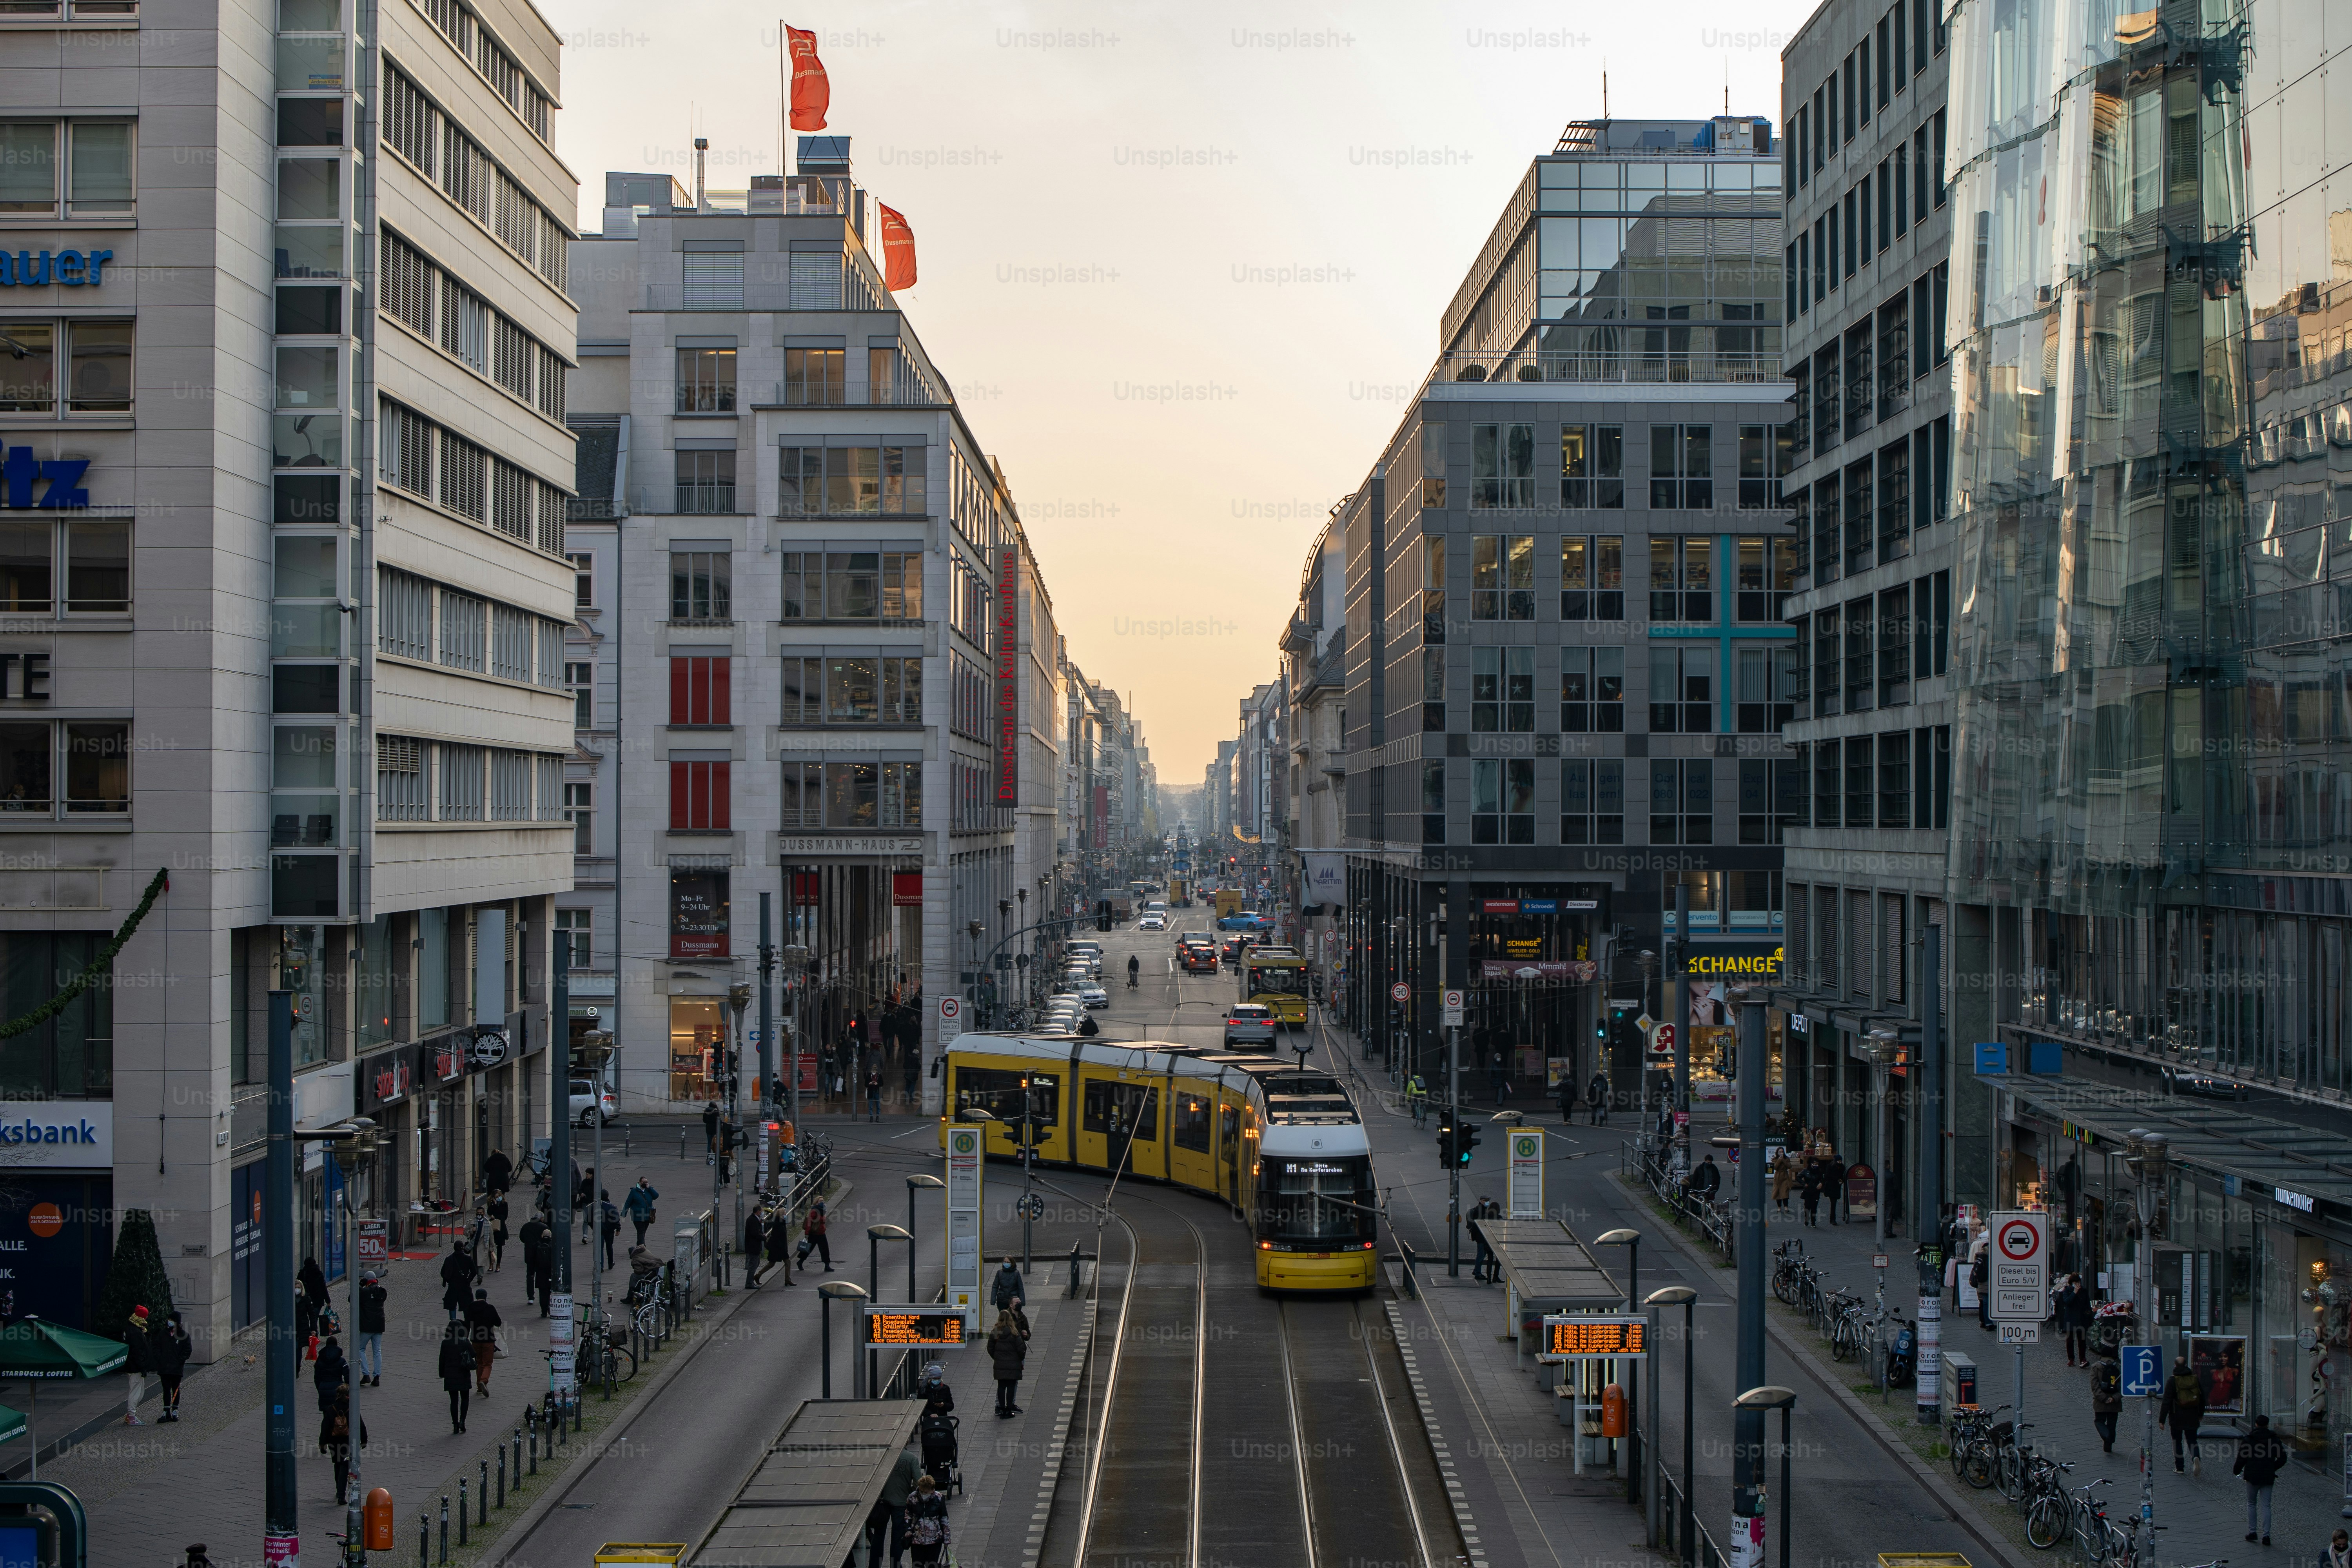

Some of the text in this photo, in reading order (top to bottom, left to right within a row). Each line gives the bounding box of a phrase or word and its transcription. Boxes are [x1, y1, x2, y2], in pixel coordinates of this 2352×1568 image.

[795, 69, 826, 79] Dussmann
[999, 552, 1013, 800] Dussmann das KulturKaufhaus
[780, 839, 895, 850] DUSSMANN-HAUS
[1396, 988, 1406, 996] 30
[1791, 1014, 1808, 1033] DEPOT
[436, 1050, 450, 1077] shoe
[377, 1067, 393, 1098] shoe
[1287, 1164, 1296, 1172] M1
[2002, 1327, 2021, 1338] 100
[97, 1361, 114, 1372] STARBUCKS
[2139, 1359, 2153, 1383] P
[12, 1425, 26, 1435] COFFEE
